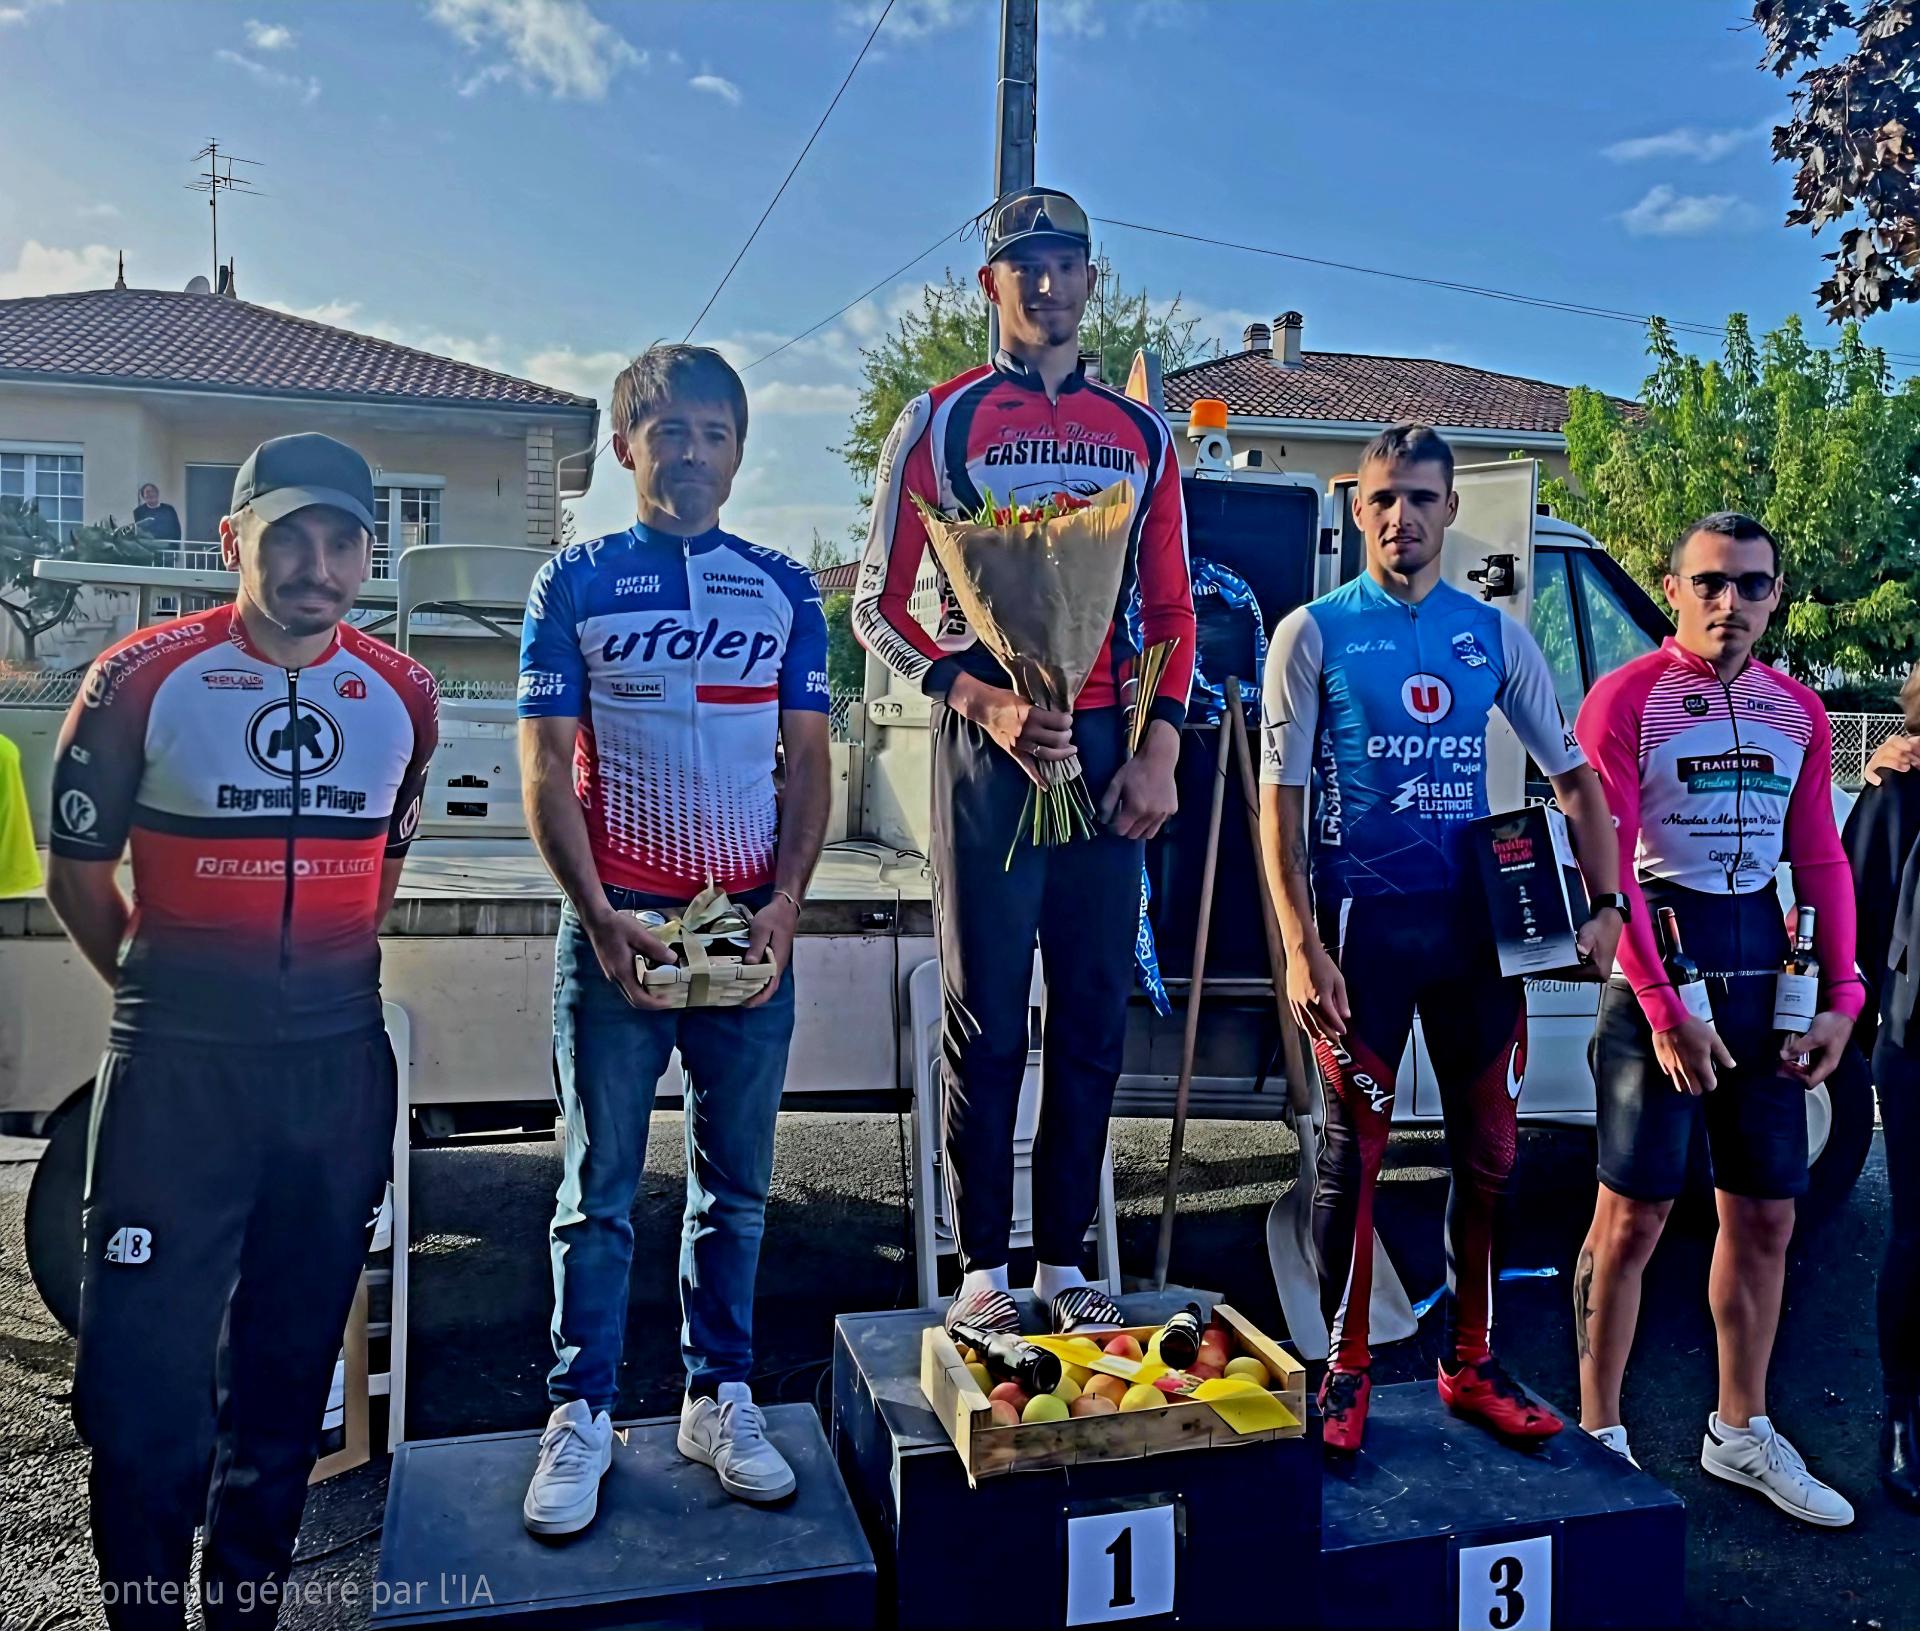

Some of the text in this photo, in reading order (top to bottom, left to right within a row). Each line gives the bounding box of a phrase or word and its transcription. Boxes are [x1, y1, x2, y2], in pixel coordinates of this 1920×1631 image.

[984, 438, 1136, 475] CASTELJALOUX
[614, 584, 661, 596] SPORT
[702, 572, 765, 587] CHAMPION
[706, 586, 764, 599] NATIONAL
[602, 617, 778, 681] ufolep
[1411, 687, 1440, 713] U
[1366, 735, 1482, 766] express
[315, 784, 367, 814] Pliage
[1416, 781, 1474, 798] BEADE
[1105, 1526, 1136, 1609] 1
[1488, 1555, 1525, 1630] 3
